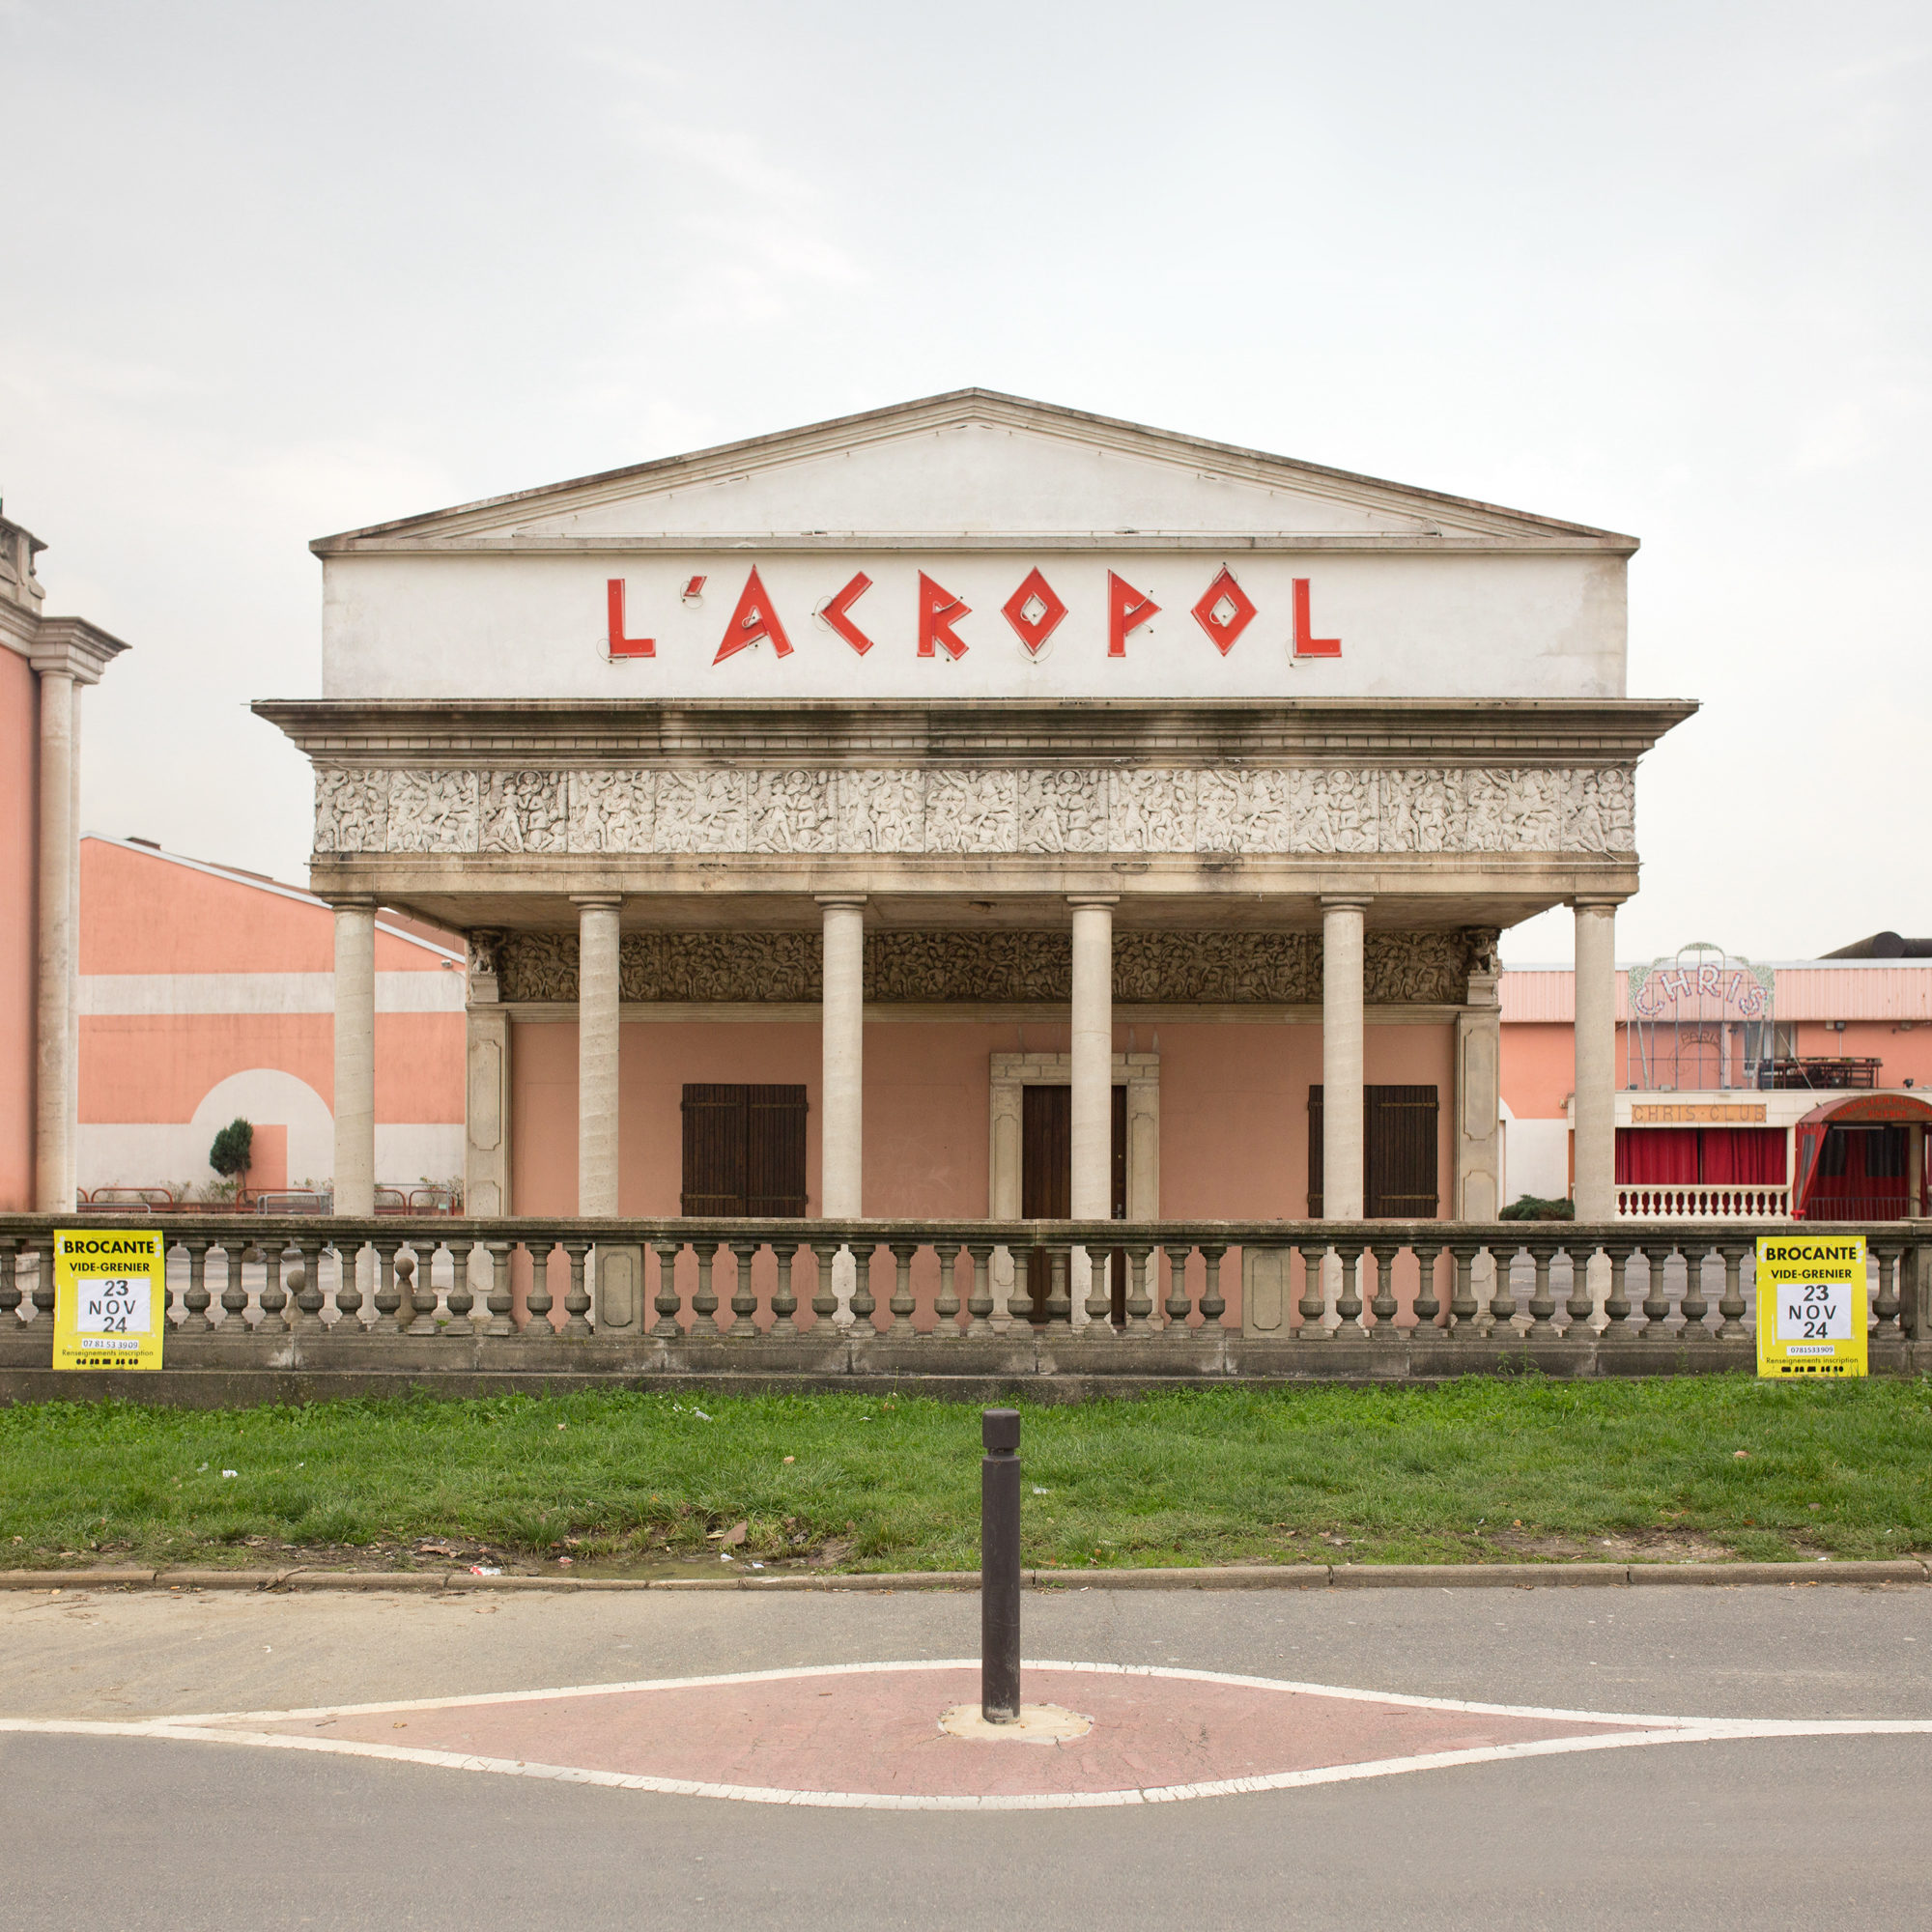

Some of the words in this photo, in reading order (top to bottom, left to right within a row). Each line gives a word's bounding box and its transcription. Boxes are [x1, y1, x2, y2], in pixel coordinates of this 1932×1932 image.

[607, 563, 1343, 666] L'ACROPOL
[1634, 964, 1768, 1015] CHRIS
[64, 1240, 155, 1254] BROCANTE
[1766, 1247, 1857, 1261] BROCANTE
[70, 1262, 150, 1272] VIDE-GRENIER
[1771, 1269, 1852, 1279] VIDE-GRENIER
[103, 1280, 128, 1296] 23
[1803, 1285, 1829, 1301] 23
[89, 1300, 136, 1315] NOV
[1789, 1305, 1836, 1320] NOV
[103, 1317, 128, 1333] 24
[1803, 1321, 1828, 1338] 24
